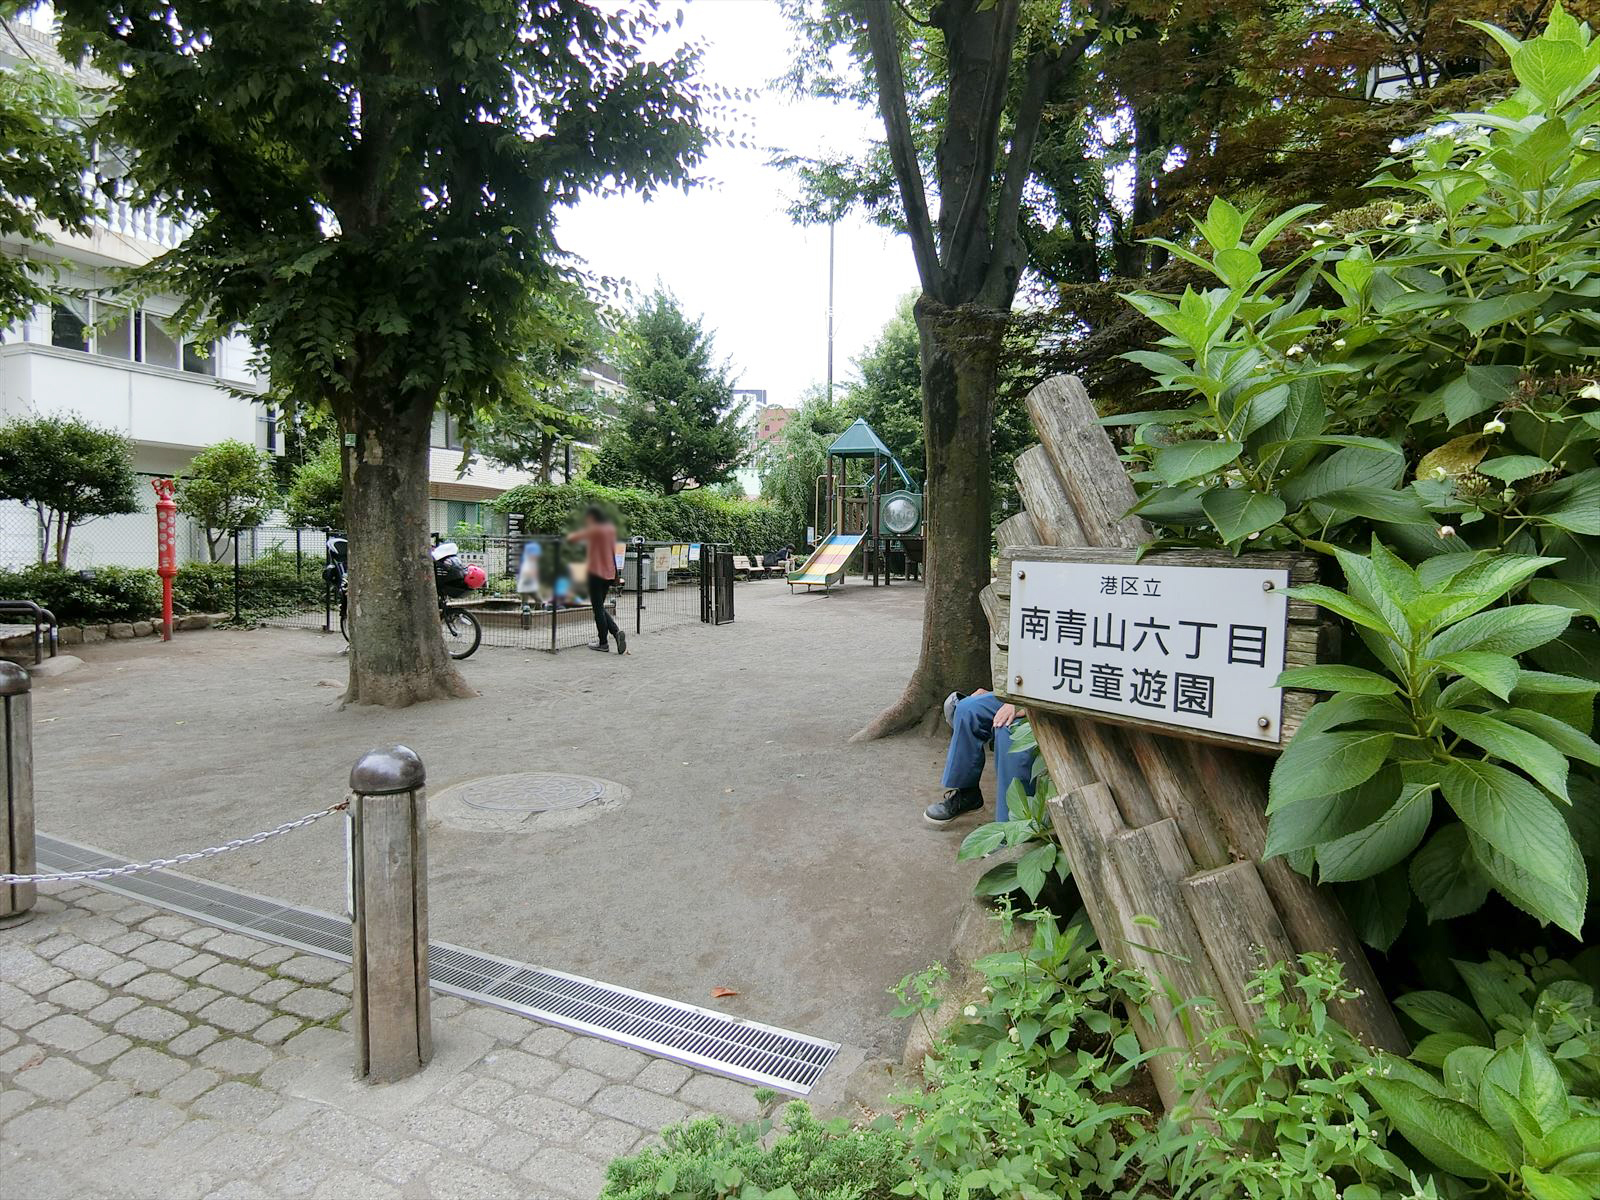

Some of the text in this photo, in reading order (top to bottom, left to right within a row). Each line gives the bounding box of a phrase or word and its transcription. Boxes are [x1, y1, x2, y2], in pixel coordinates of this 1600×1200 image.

[1100, 576, 1162, 597] 港区立
[1020, 606, 1268, 668] 南青山六丁目
[1052, 656, 1215, 718] 児童遊園
